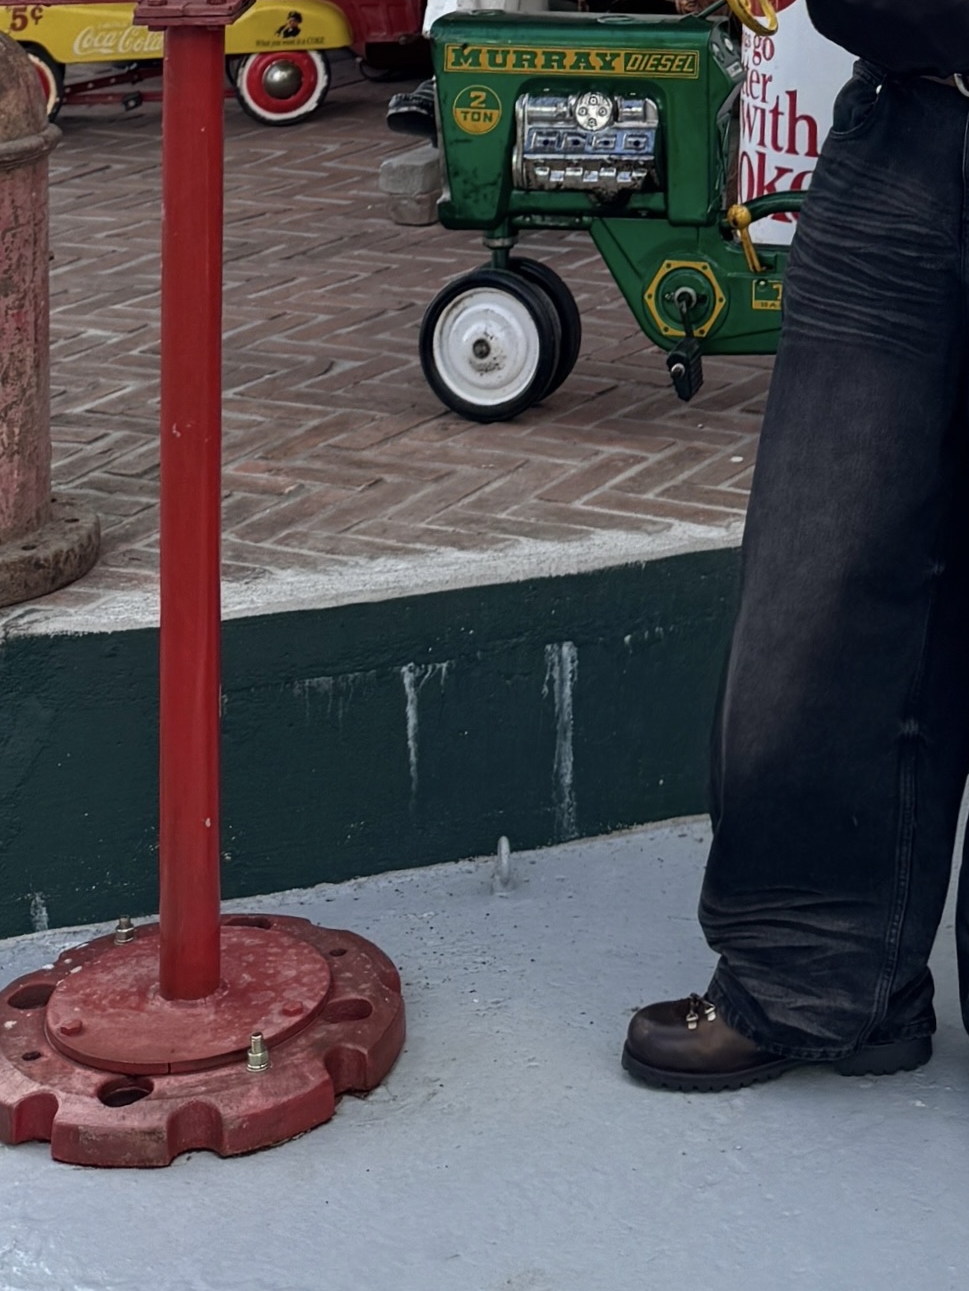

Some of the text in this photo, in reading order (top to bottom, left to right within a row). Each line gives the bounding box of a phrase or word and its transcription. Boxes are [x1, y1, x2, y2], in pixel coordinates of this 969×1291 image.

[450, 48, 694, 73] MURRAY DIESEL
[469, 91, 486, 108] 2
[460, 110, 493, 123] TON
